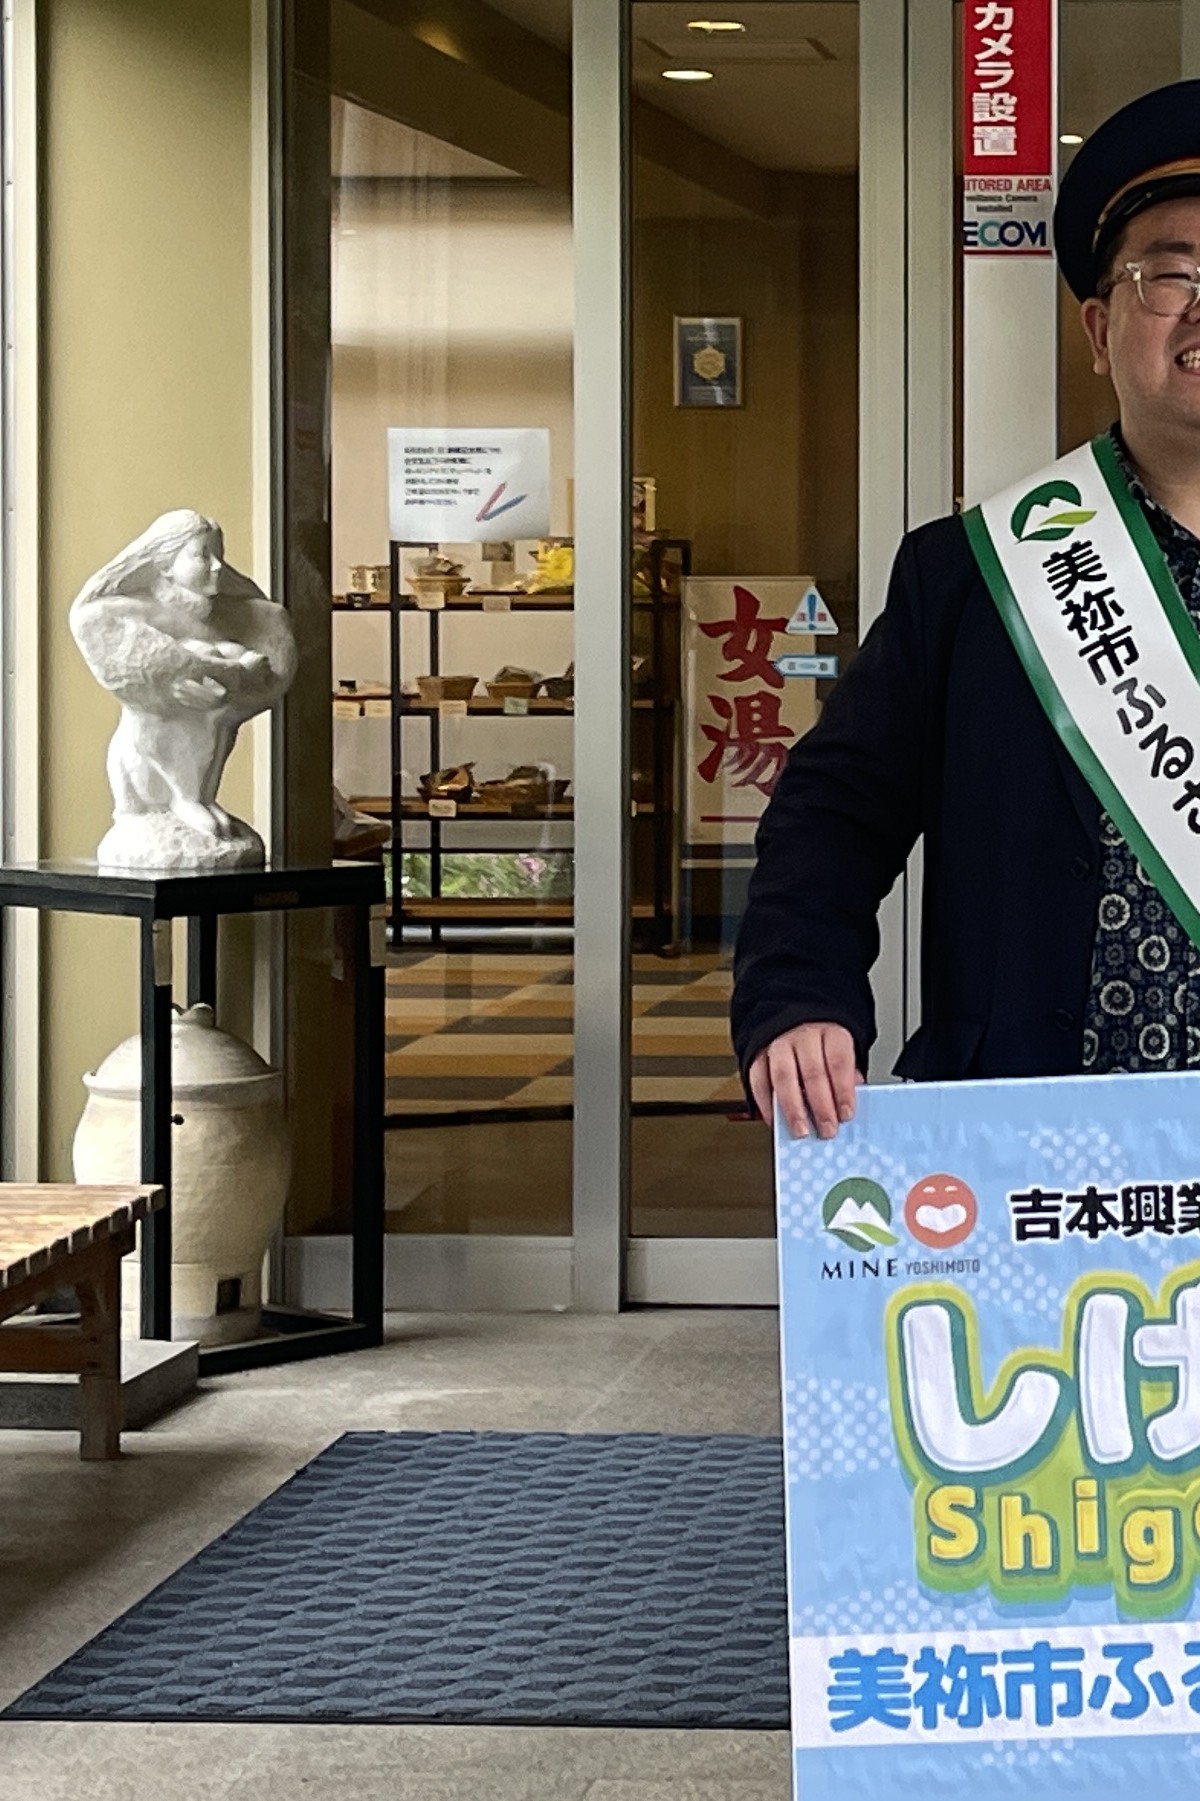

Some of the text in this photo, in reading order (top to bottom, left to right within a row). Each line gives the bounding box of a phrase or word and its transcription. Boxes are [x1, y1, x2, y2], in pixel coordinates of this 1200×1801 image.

[972, 2, 1017, 156] カメラ設置
[1016, 179, 1052, 192] AREA
[698, 585, 795, 797] 女湯
[820, 1257, 898, 1280] MINE
[904, 1258, 981, 1276] YOSHIMOTO
